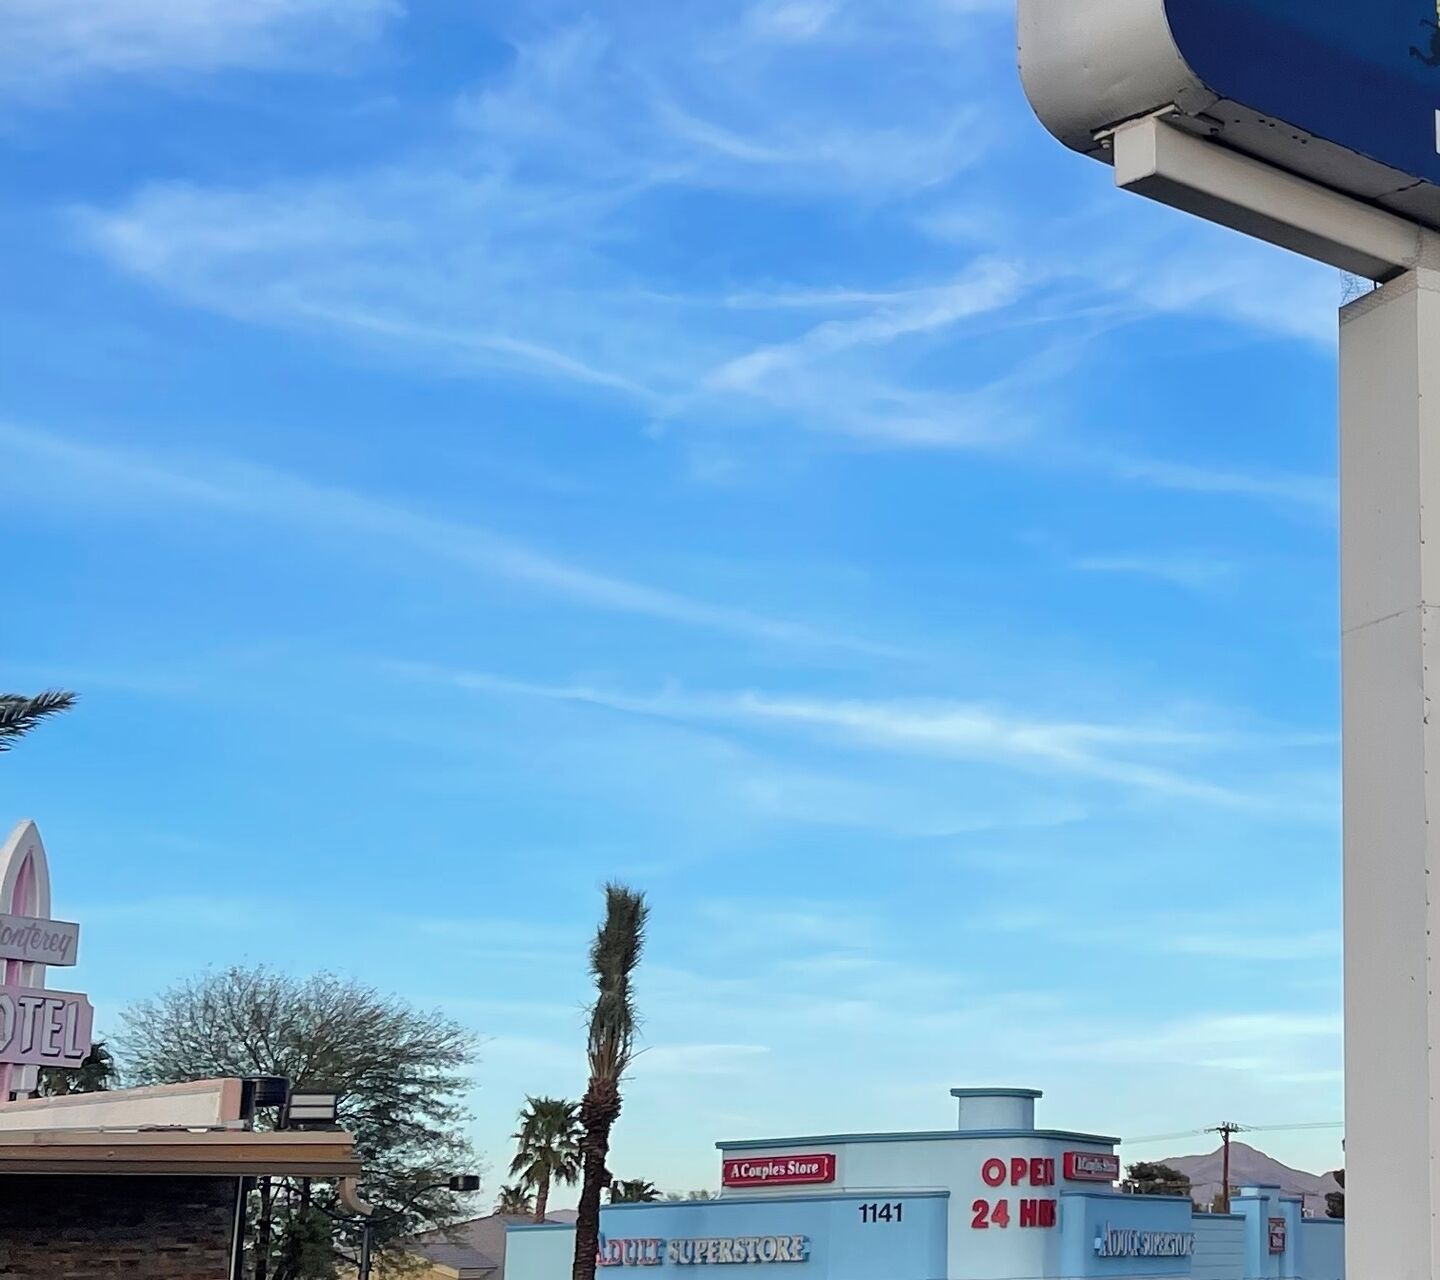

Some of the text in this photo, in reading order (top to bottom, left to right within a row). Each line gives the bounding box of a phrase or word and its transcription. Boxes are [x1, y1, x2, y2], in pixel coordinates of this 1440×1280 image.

[0, 922, 73, 961] onterey
[0, 992, 84, 1060] OTEL
[731, 1163, 740, 1178] A
[787, 1160, 819, 1176] Store
[981, 1157, 1056, 1188] OPEN
[858, 1202, 903, 1224] 1141
[971, 1199, 1010, 1229] 24
[668, 1234, 811, 1265] SUPERSTORE
